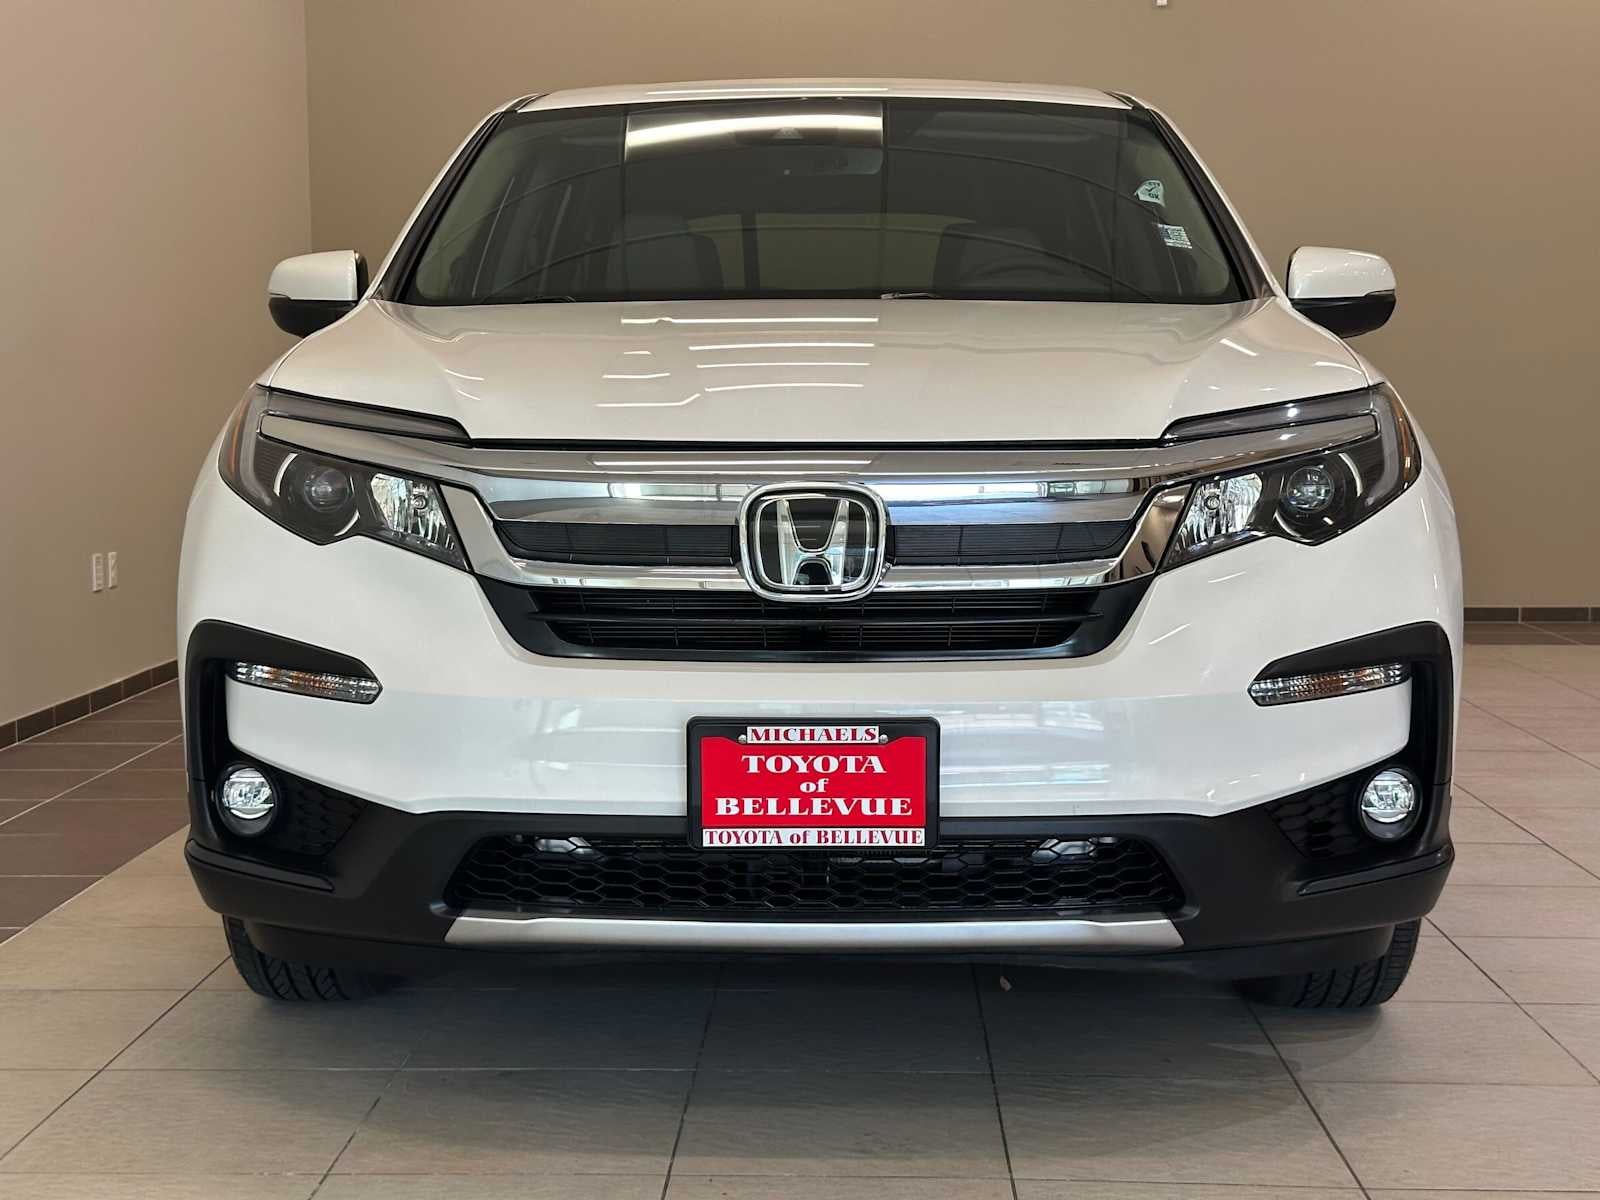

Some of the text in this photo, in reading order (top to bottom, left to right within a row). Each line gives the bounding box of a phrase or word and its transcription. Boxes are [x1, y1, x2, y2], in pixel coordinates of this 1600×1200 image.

[750, 727, 876, 742] MICHAELS
[741, 755, 886, 773] TOYOTA
[799, 778, 829, 793] of
[715, 797, 912, 816] BELLEVUE
[705, 829, 923, 844] TOYOTA of BELLEVUE
